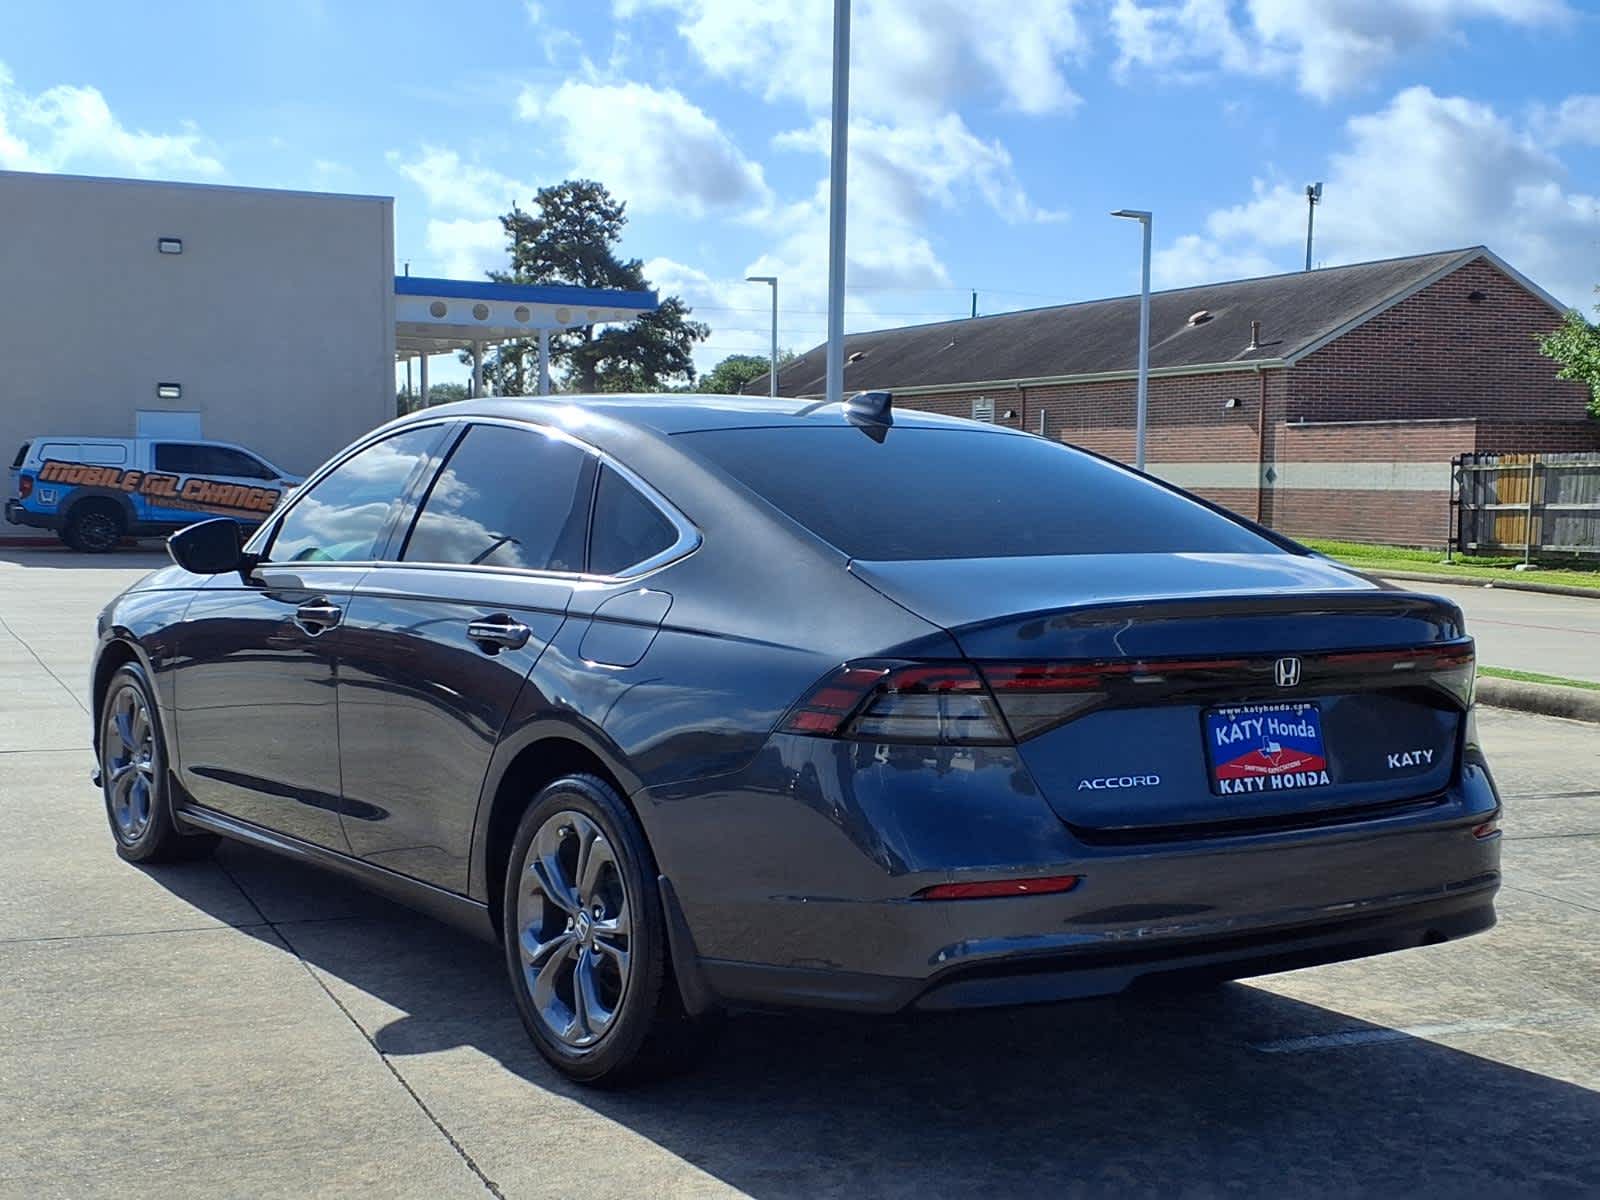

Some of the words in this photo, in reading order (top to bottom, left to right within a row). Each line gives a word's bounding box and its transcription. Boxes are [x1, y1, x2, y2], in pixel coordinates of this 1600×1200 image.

[39, 460, 140, 491] MOBILE
[140, 473, 179, 497] OIL
[181, 479, 280, 511] CHANGE
[1219, 703, 1311, 715] www.katyhonda.com
[1216, 718, 1263, 746] KATY
[1268, 718, 1316, 738] Honda
[1387, 749, 1433, 769] KATY
[1078, 775, 1160, 790] ACCORD
[1220, 776, 1265, 794] KATY
[1271, 771, 1330, 789] HONDA
